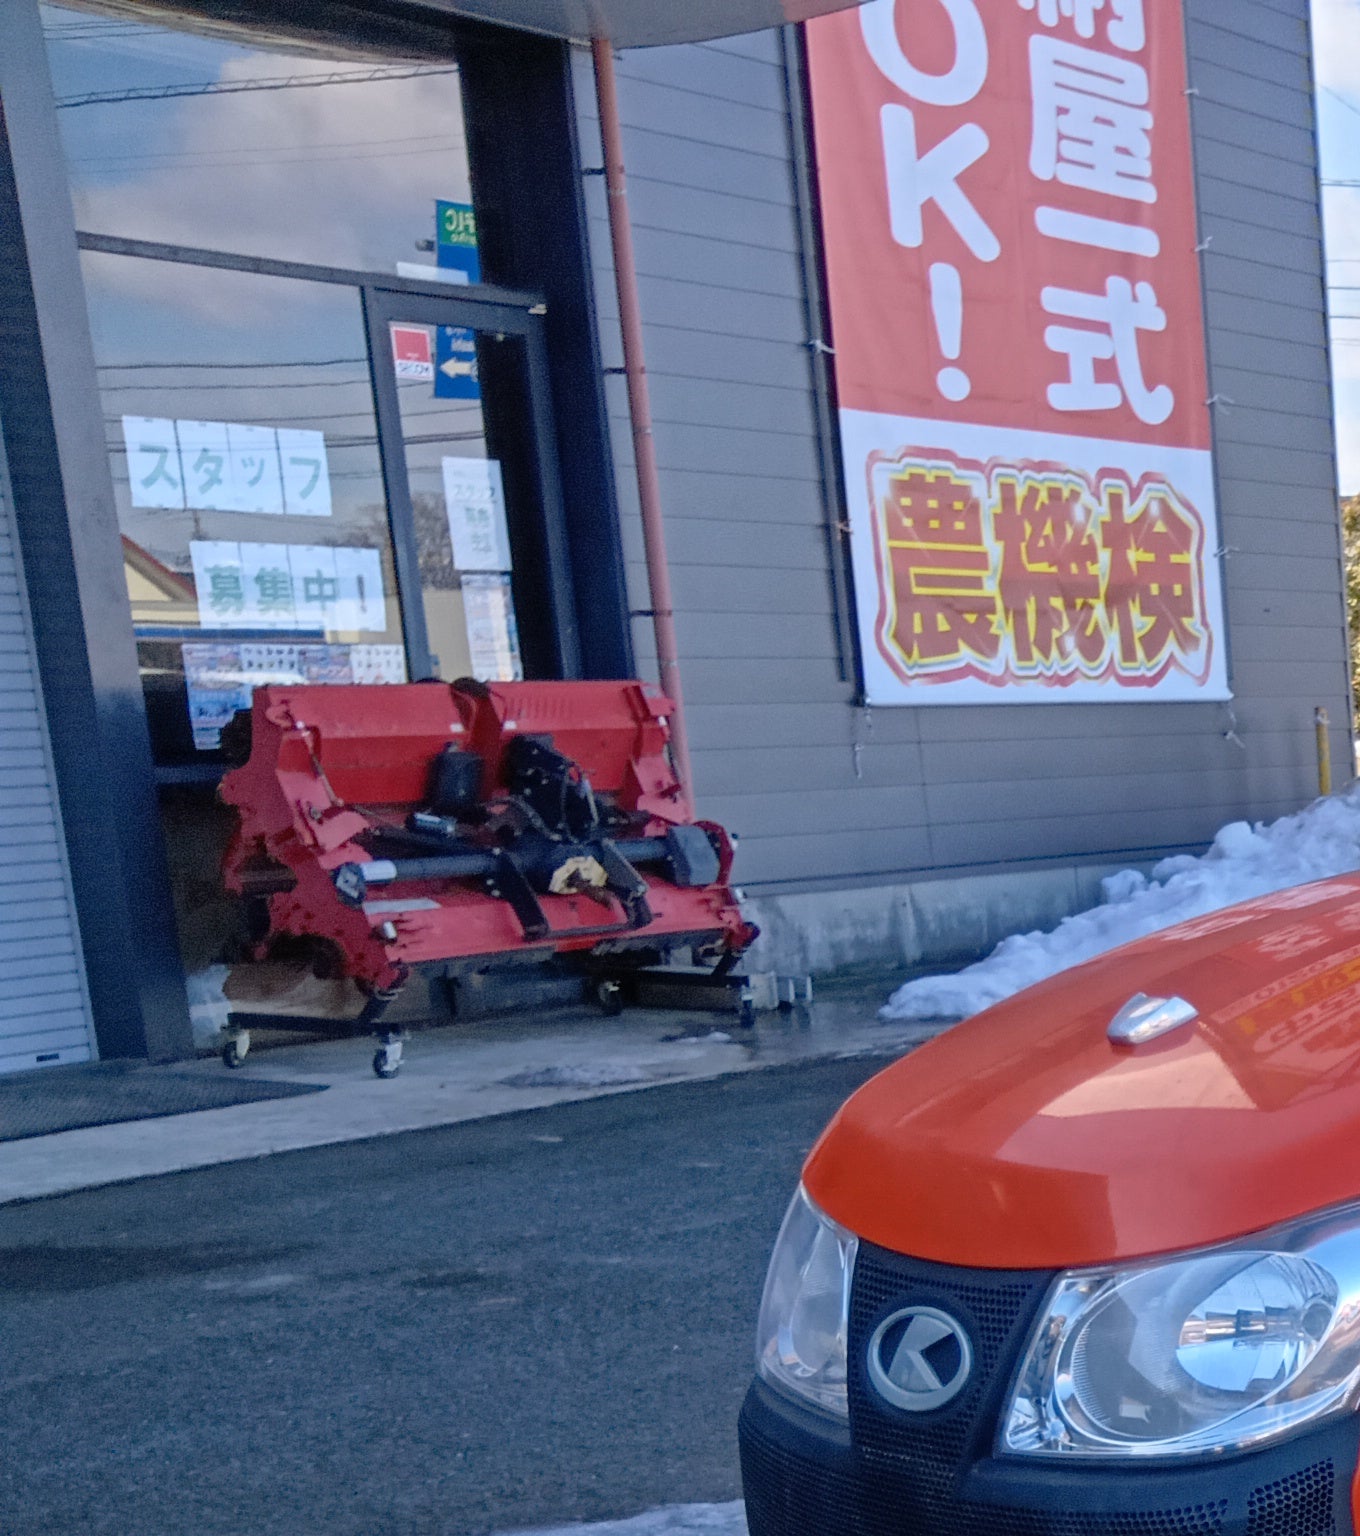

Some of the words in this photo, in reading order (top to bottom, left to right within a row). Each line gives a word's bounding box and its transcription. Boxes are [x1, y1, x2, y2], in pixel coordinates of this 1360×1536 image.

[138, 443, 323, 501] スタッフ
[203, 563, 369, 617] 募集中!
[882, 465, 1201, 669] 農機検
